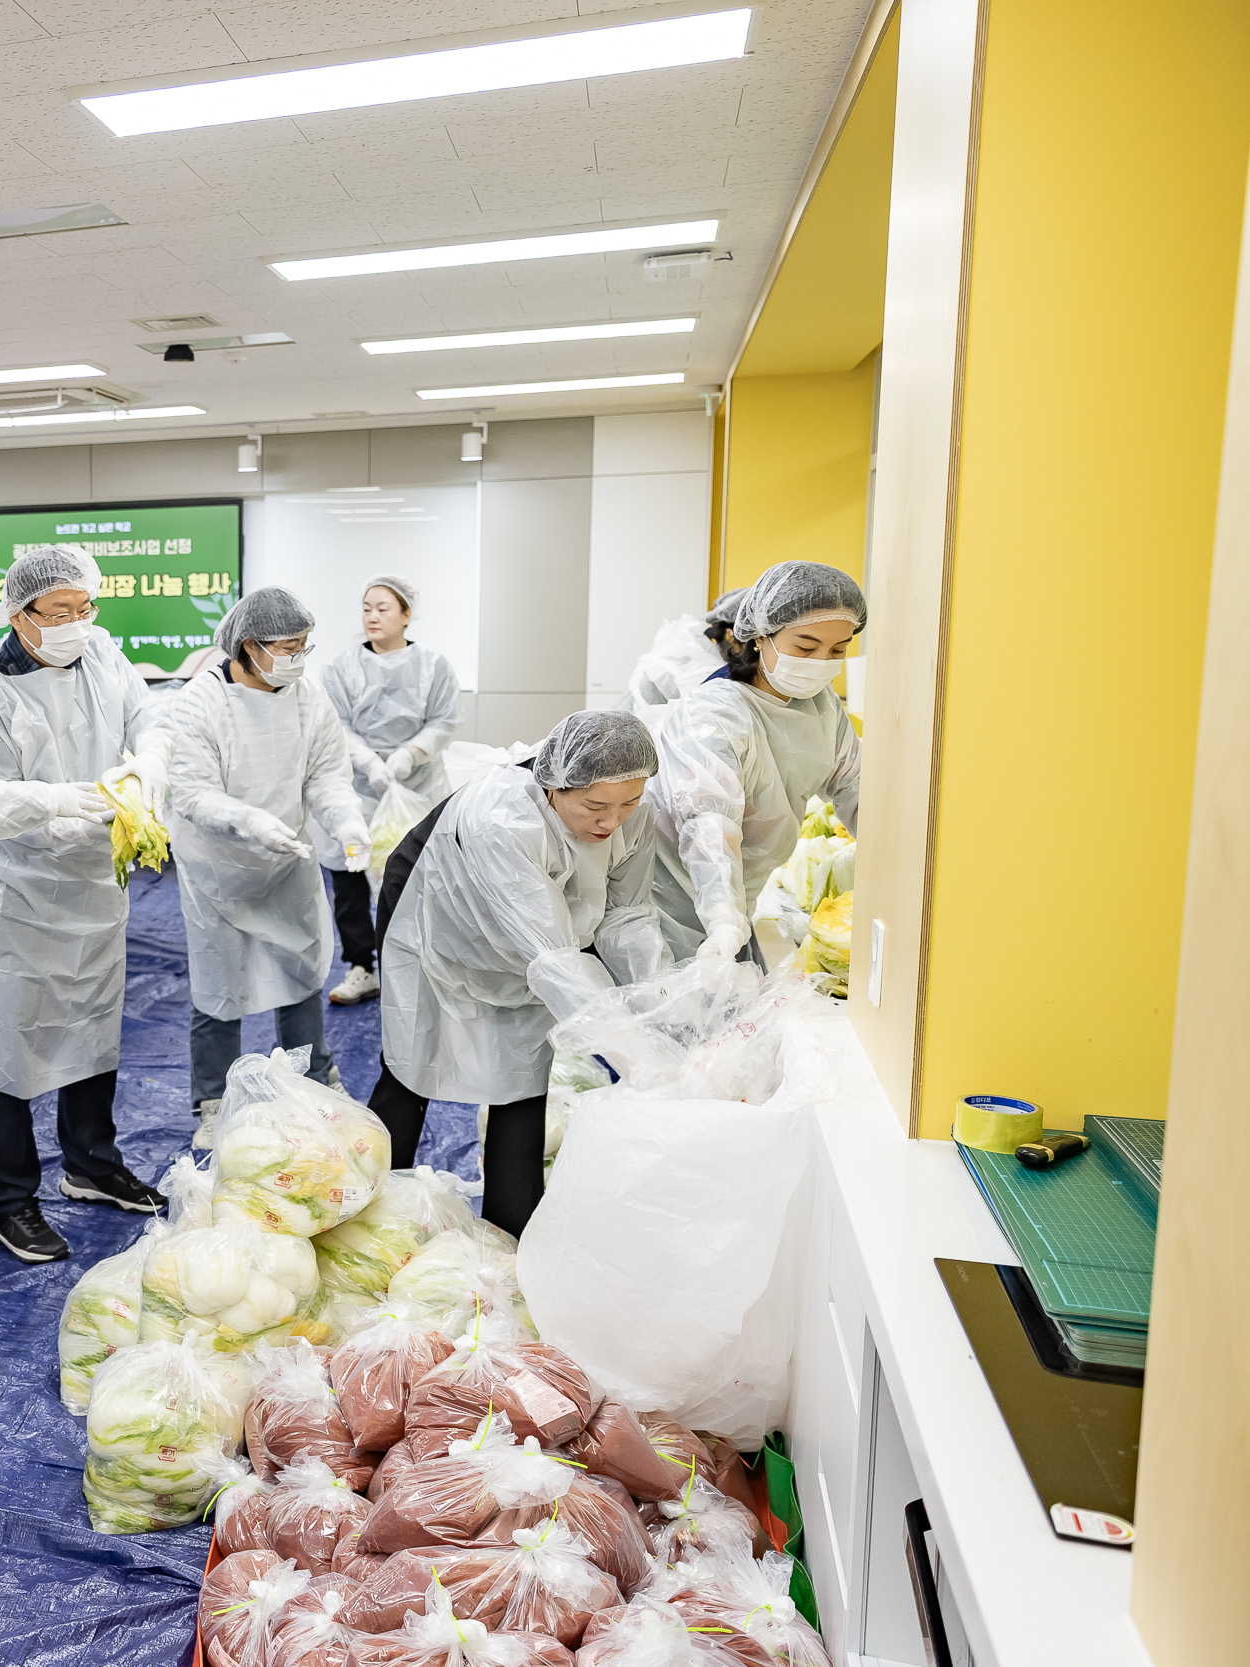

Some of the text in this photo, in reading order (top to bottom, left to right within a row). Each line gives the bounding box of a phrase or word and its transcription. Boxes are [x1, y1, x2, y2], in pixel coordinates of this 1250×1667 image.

[164, 538, 192, 555] 선정
[140, 573, 183, 597] 나눔
[188, 572, 231, 596] 행사
